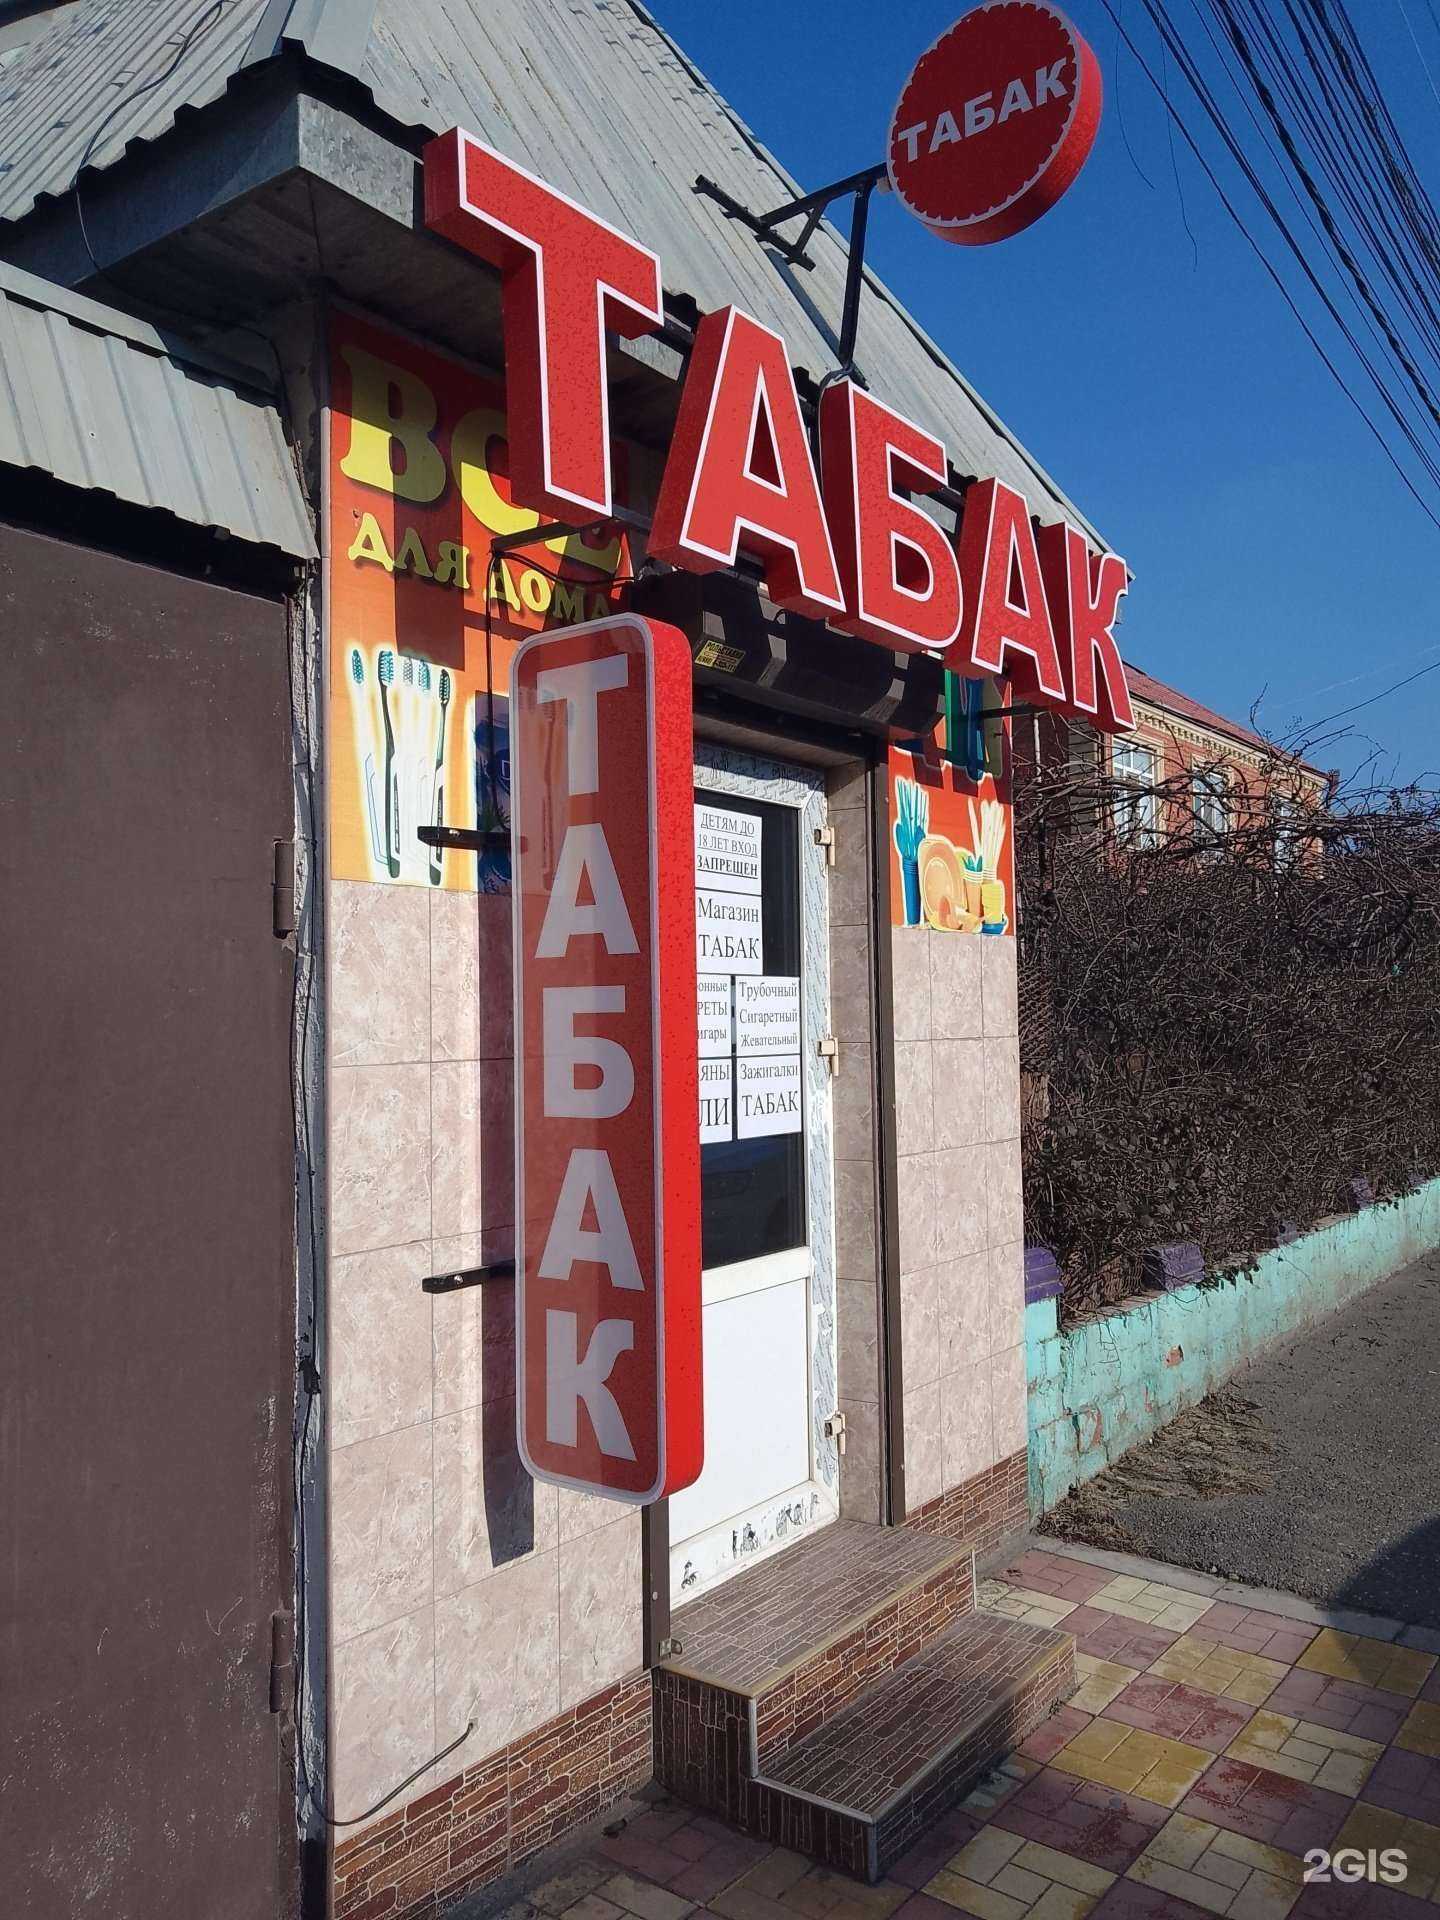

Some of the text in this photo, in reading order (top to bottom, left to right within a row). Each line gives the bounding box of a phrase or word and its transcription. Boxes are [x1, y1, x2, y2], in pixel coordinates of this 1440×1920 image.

[898, 57, 1068, 163] ТАБАК
[456, 128, 1138, 732] ТАБАК
[348, 512, 471, 589] ДЛЯ
[700, 812, 755, 836] ДЕТЯМ ДО
[697, 834, 758, 857] 18 ЛЕТ ВХОД
[697, 854, 758, 877] ЗАПРЕЩЕН
[698, 896, 760, 923] Магазин
[698, 934, 760, 960] ТАБАК
[698, 982, 728, 993] онные
[739, 981, 797, 1002] Трубочный
[697, 1001, 728, 1016] РЕТЫ
[739, 1008, 798, 1028] Сигаретный
[698, 1027, 727, 1043] игары
[740, 1032, 798, 1047] Жевательный
[534, 653, 646, 1462] ТАБАК
[698, 1064, 730, 1081] ЯНЫ
[740, 1063, 798, 1080] Зажигалки
[698, 1098, 731, 1127] ЛИ
[742, 1090, 799, 1117] ТАБАК
